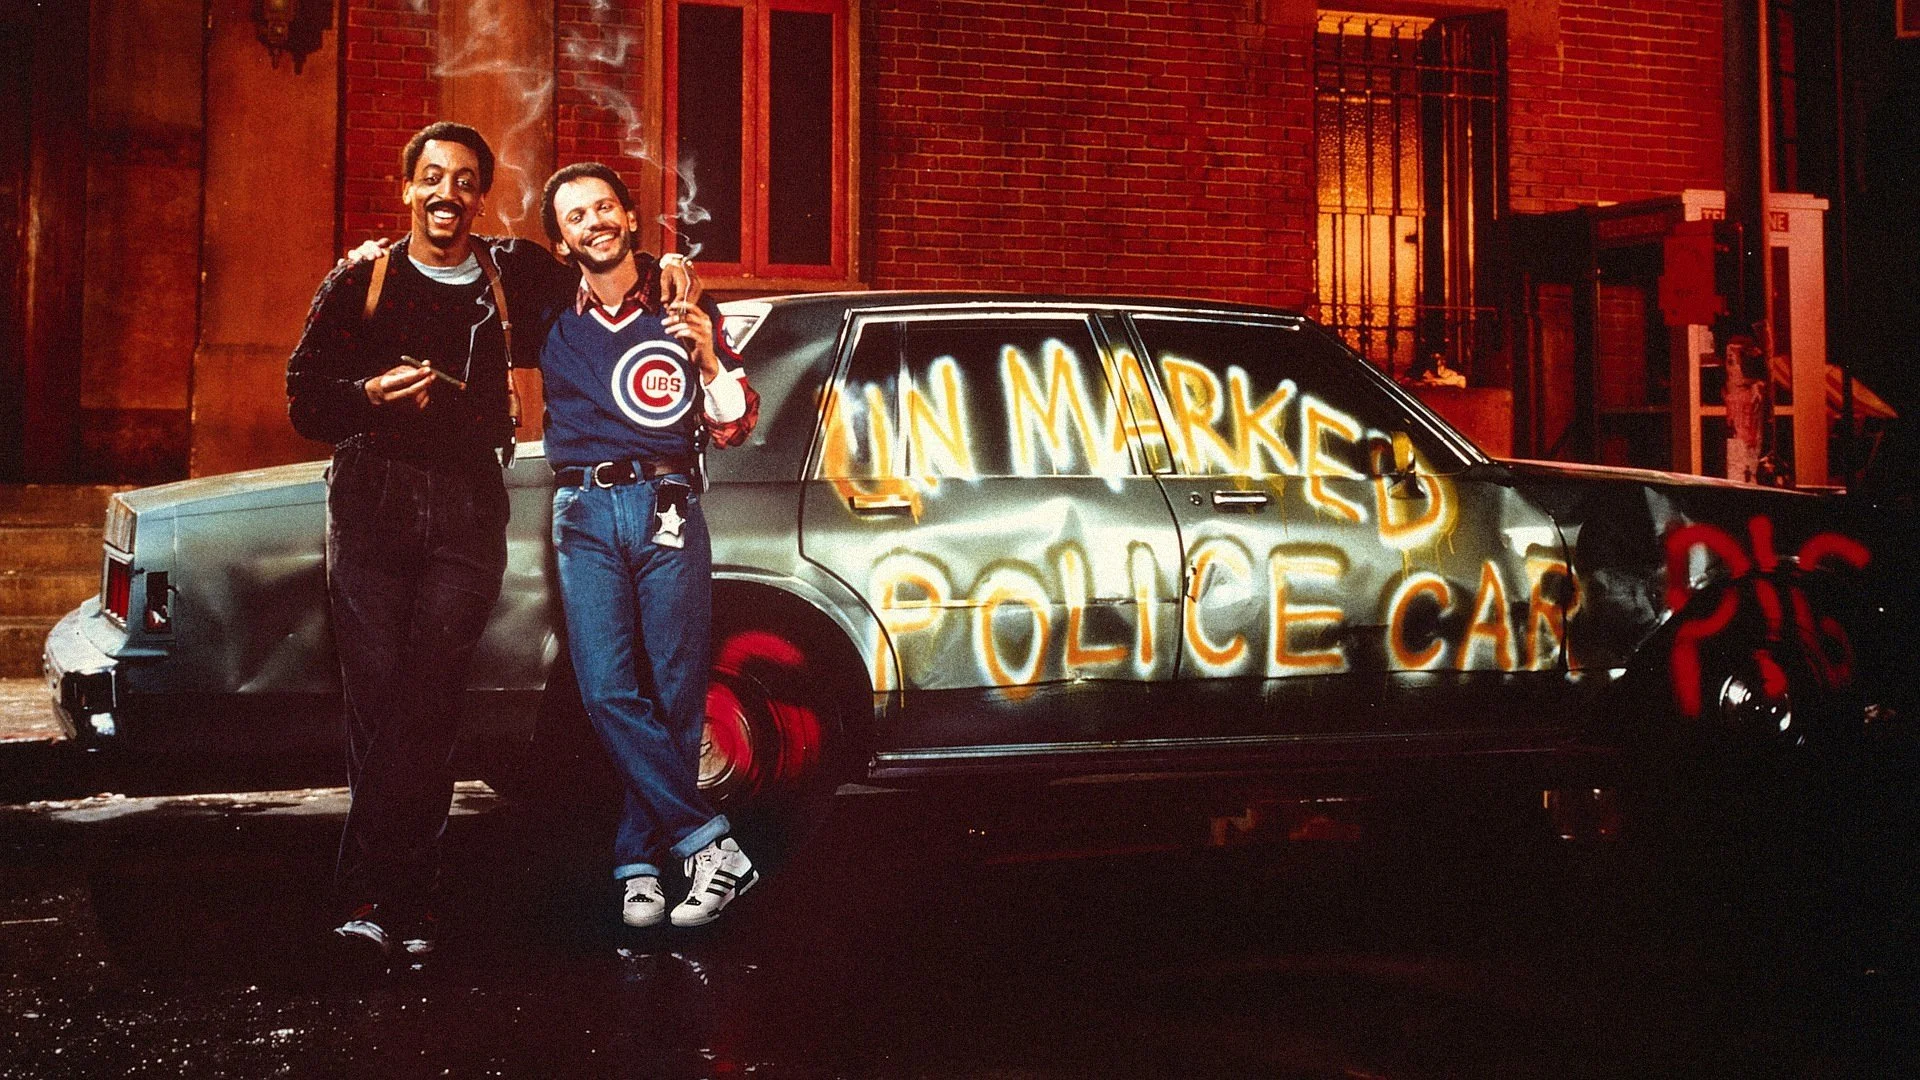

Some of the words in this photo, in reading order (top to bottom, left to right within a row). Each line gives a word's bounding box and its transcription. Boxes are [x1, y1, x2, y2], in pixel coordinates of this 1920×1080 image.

[632, 359, 681, 408] CUBS
[819, 354, 978, 522] UN
[1001, 339, 1455, 548] MARKED
[868, 530, 1349, 703] POLICE
[1382, 546, 1582, 680] CAR
